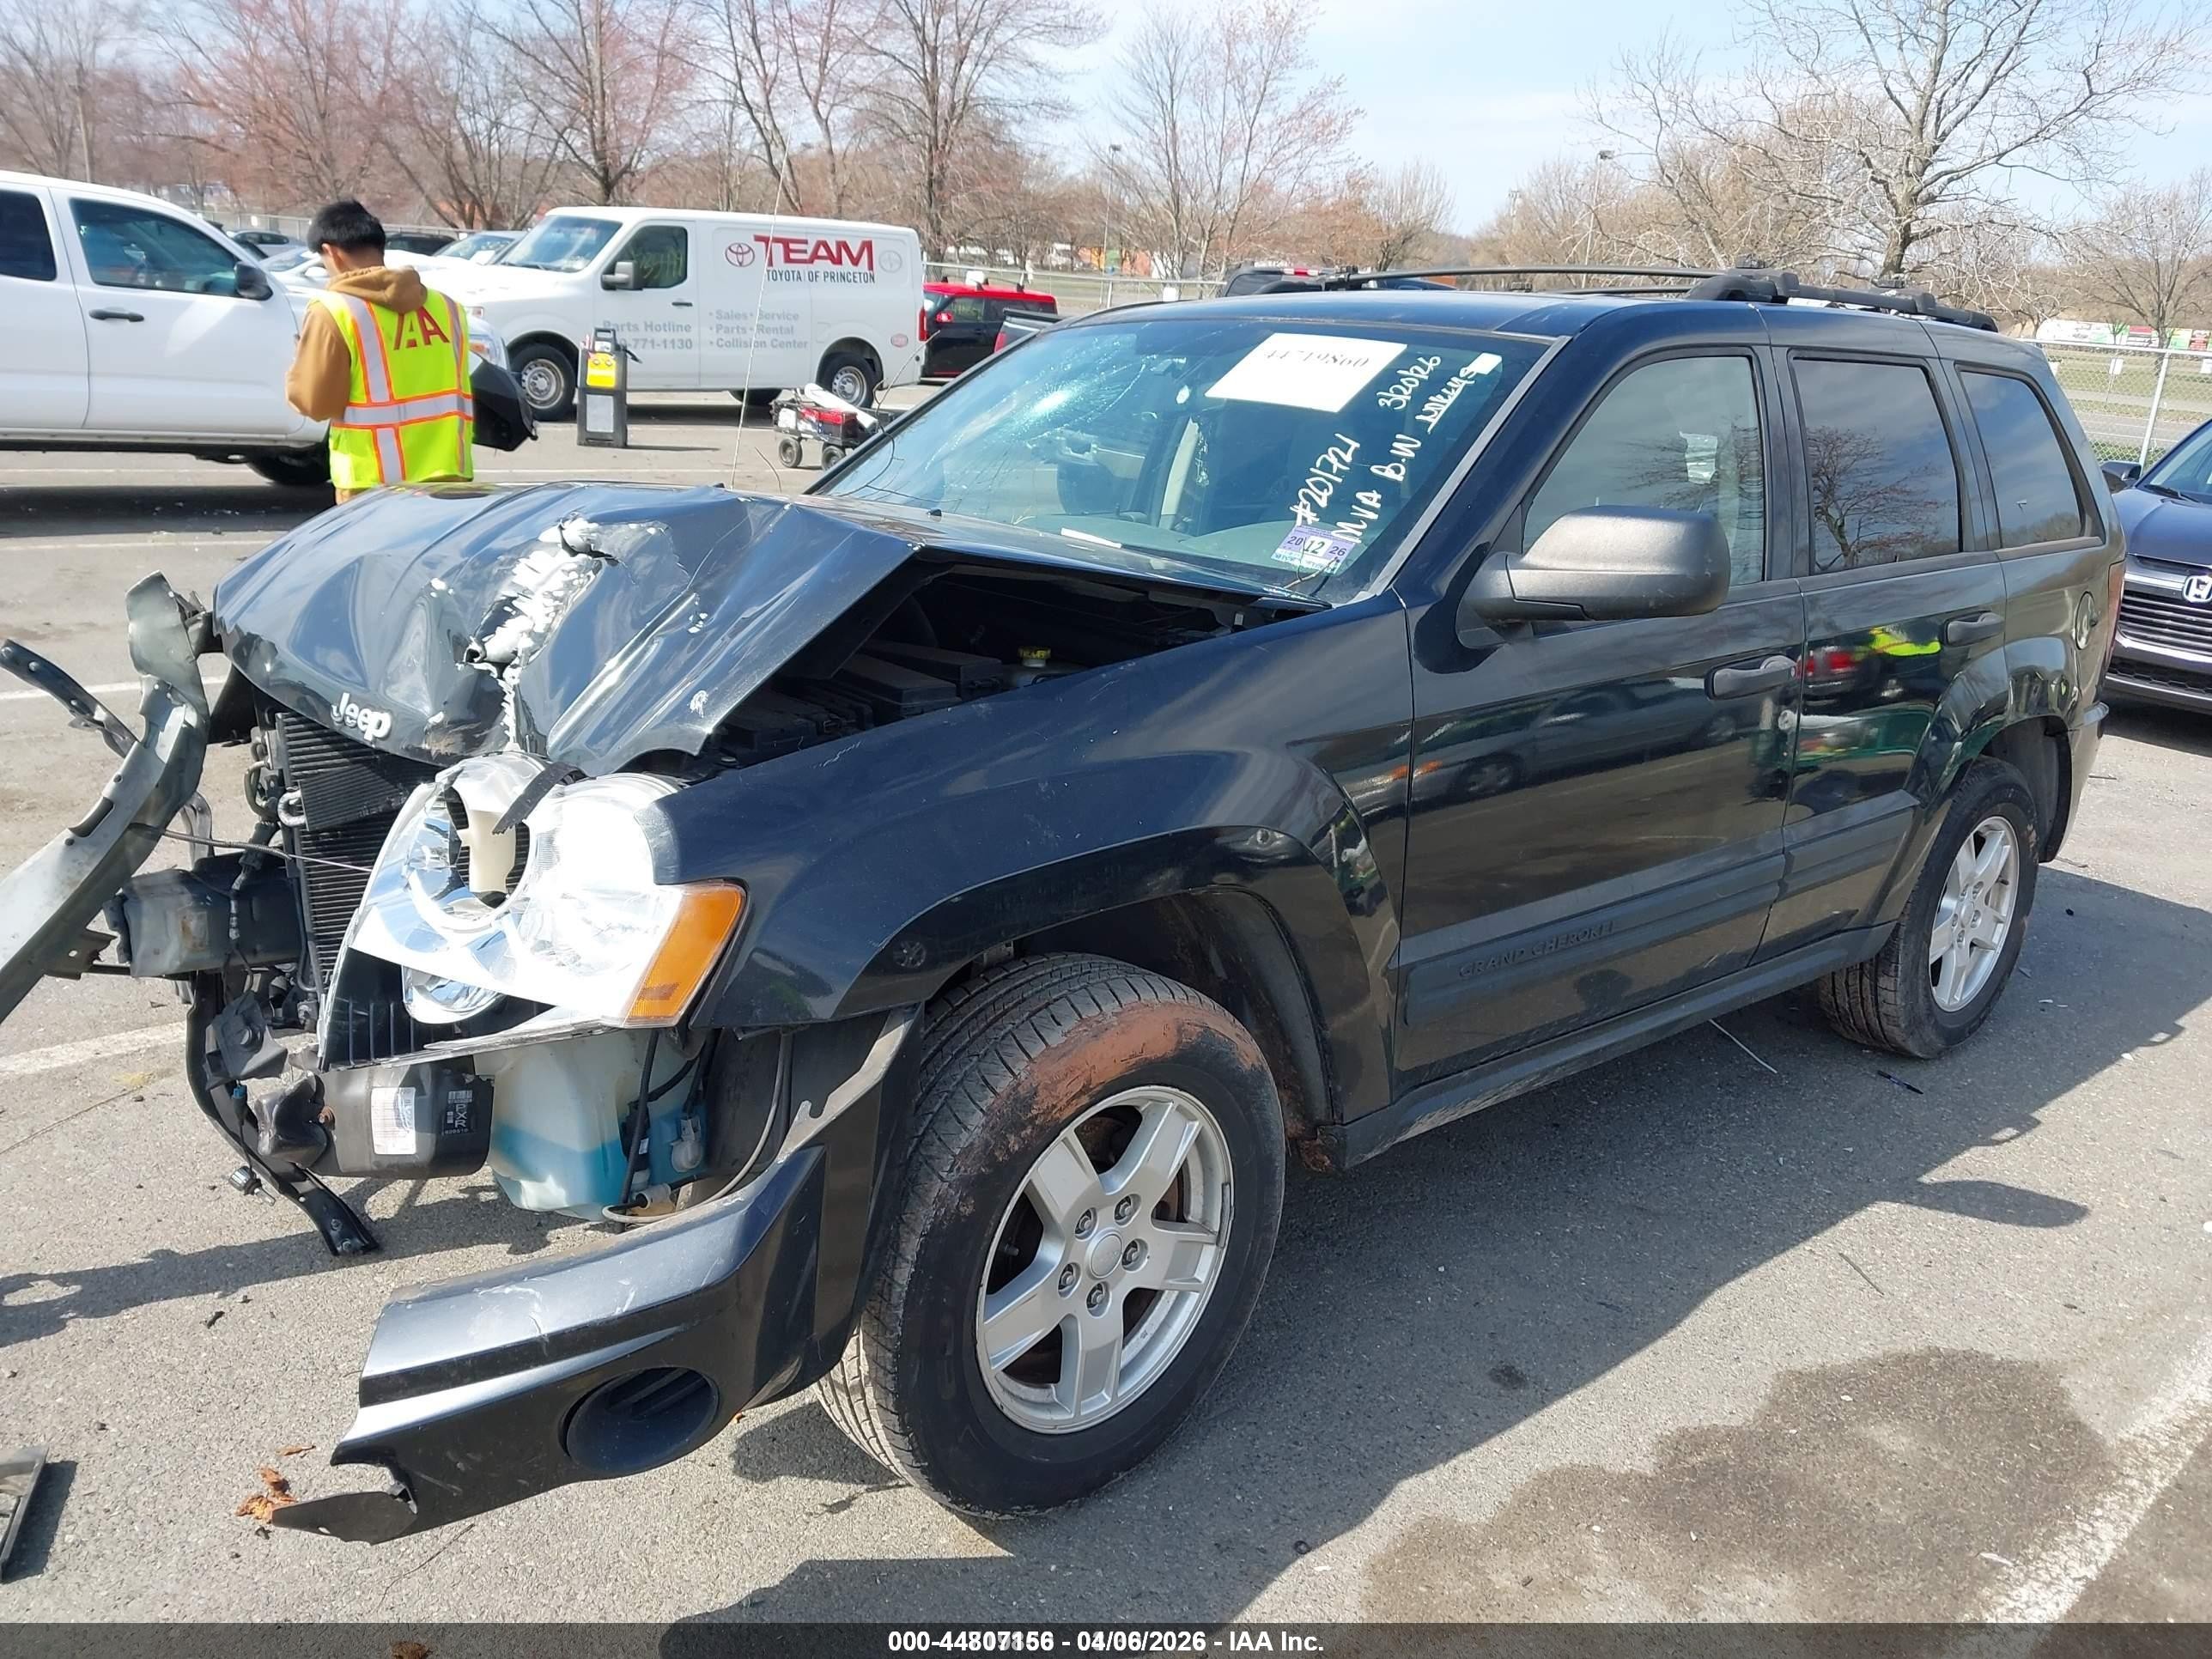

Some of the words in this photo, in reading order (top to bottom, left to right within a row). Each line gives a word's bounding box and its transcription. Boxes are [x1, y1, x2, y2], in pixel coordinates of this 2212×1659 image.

[753, 234, 875, 271] TEAM
[766, 270, 801, 283] TOYOTA
[808, 270, 820, 283] OF
[823, 270, 875, 283] PRINCETON
[715, 310, 748, 320] Sales
[757, 310, 799, 321] Service
[645, 321, 692, 333] Hotline
[715, 324, 747, 334] Parts
[756, 324, 794, 334] Rental
[716, 337, 767, 348] Collision
[770, 338, 808, 349] Center
[1287, 536, 1304, 546] 20
[1304, 540, 1325, 555] 12
[1329, 546, 1346, 556] 26
[331, 692, 392, 741] Jeep
[1459, 949, 1525, 977] GRAND
